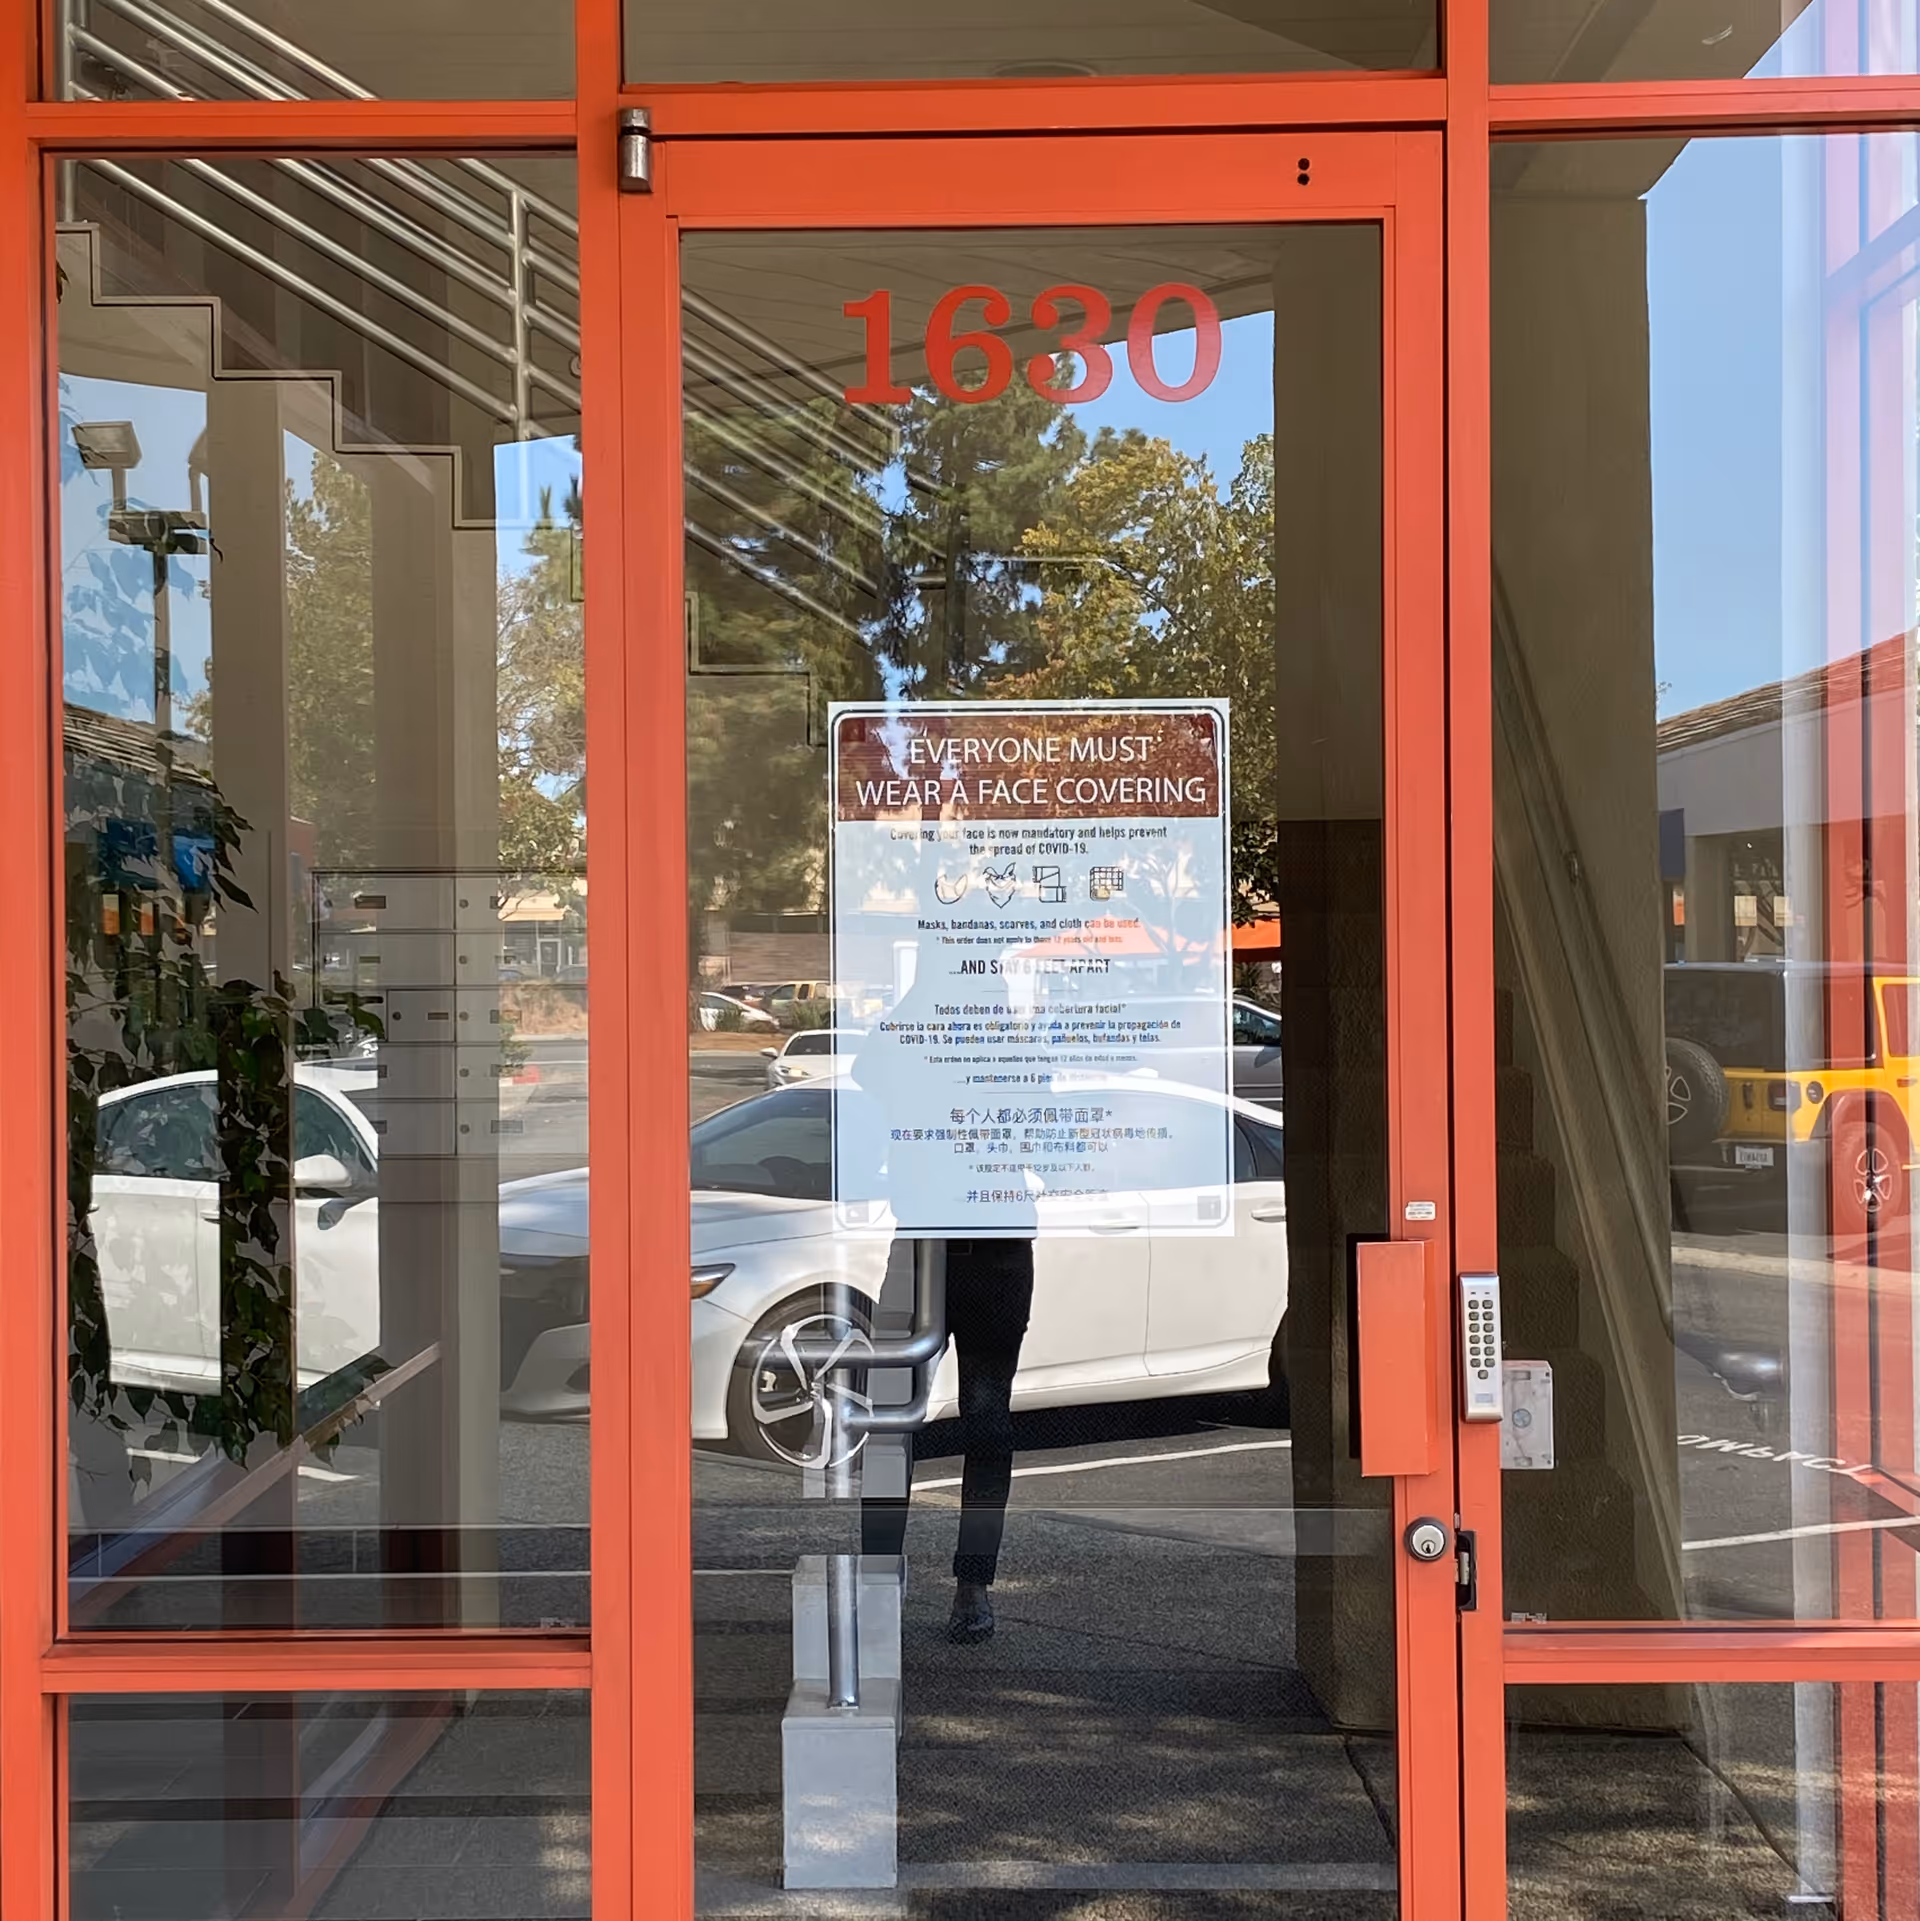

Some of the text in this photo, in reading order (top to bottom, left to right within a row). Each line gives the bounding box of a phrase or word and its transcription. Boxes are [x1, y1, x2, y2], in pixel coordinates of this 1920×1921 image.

[843, 282, 1222, 404] 1630
[910, 736, 1152, 763] EVERYONE MUST
[856, 777, 1206, 806] WEAR A FACE COVERING
[962, 827, 985, 840] face
[987, 826, 996, 840] is
[999, 828, 1019, 839] now
[1021, 826, 1075, 840] mandatory
[1077, 826, 1096, 839] and
[1099, 825, 1126, 840] helps
[1128, 826, 1168, 840] prevent
[969, 842, 1089, 857] the spread of COVID-19.
[917, 919, 949, 931] Masks,
[951, 919, 998, 931] bandanas,
[999, 919, 1038, 931] scarves,
[1039, 918, 1057, 930] and
[1059, 918, 1082, 929] cloth
[1084, 919, 1102, 929] can
[1104, 918, 1115, 929] be
[1070, 958, 1111, 974] APART
[935, 1004, 961, 1015] Todos
[962, 1004, 991, 1015] deben
[993, 1004, 1004, 1015] de
[880, 1021, 915, 1031] Cubrirse
[916, 1021, 925, 1031] la
[926, 1021, 945, 1031] cara
[947, 1021, 971, 1031] ahora
[973, 1021, 983, 1031] es
[1031, 1023, 1036, 1032] y
[1071, 1020, 1106, 1031] prevenir
[1108, 1020, 1116, 1030] la
[1170, 1019, 1181, 1029] de
[942, 1034, 953, 1044] Se
[955, 1034, 985, 1046] pueden
[987, 1035, 1005, 1044] usar
[1092, 1033, 1130, 1043] bufandas
[1132, 1034, 1137, 1044] y
[1030, 1073, 1036, 1083] 6
